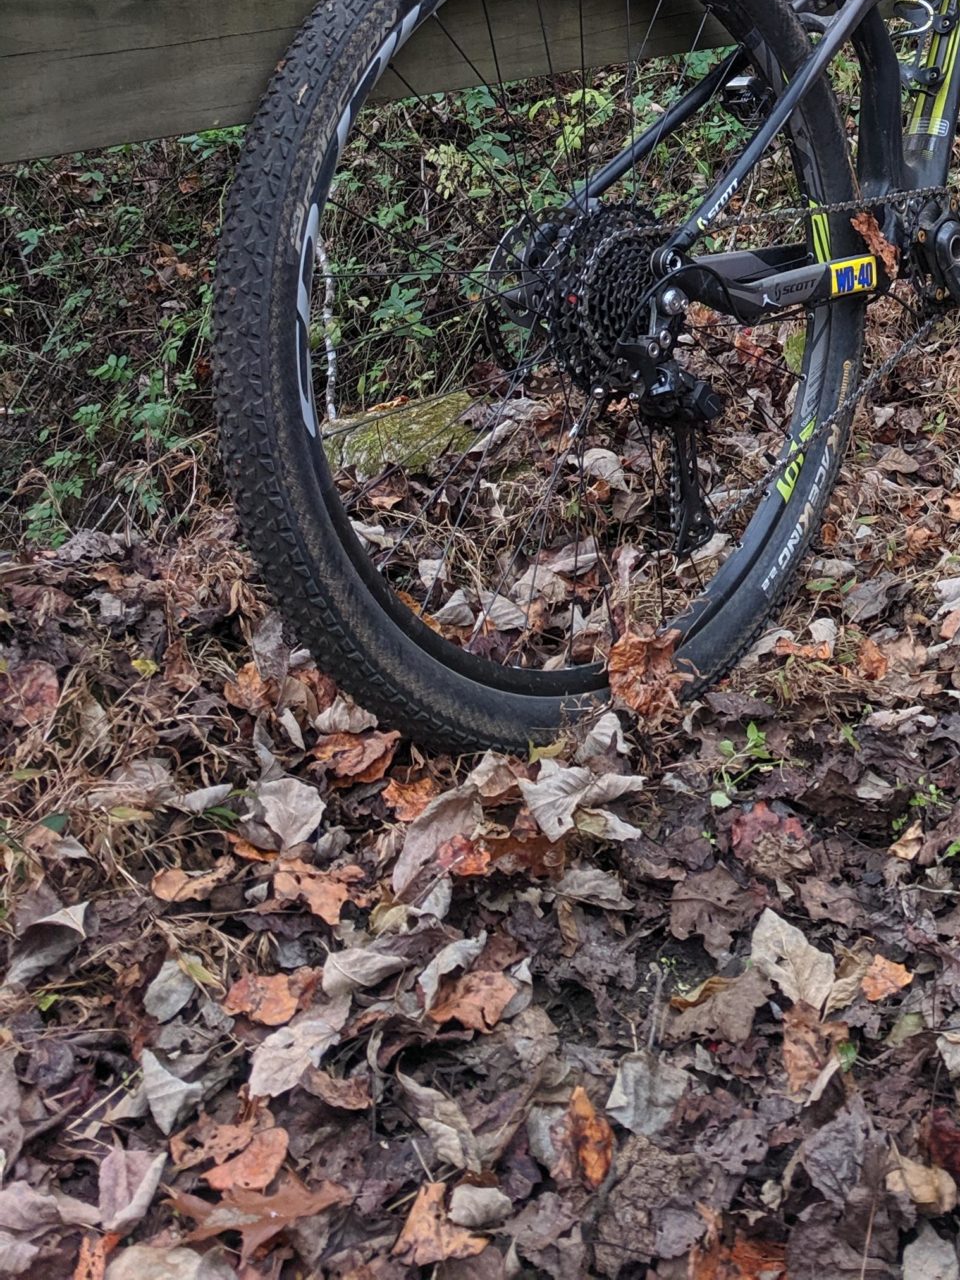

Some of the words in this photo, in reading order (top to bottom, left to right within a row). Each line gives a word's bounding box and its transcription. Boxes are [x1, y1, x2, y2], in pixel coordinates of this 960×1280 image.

[707, 178, 738, 219] SCOTT
[782, 278, 816, 296] SCOTT
[835, 262, 873, 293] WD-40
